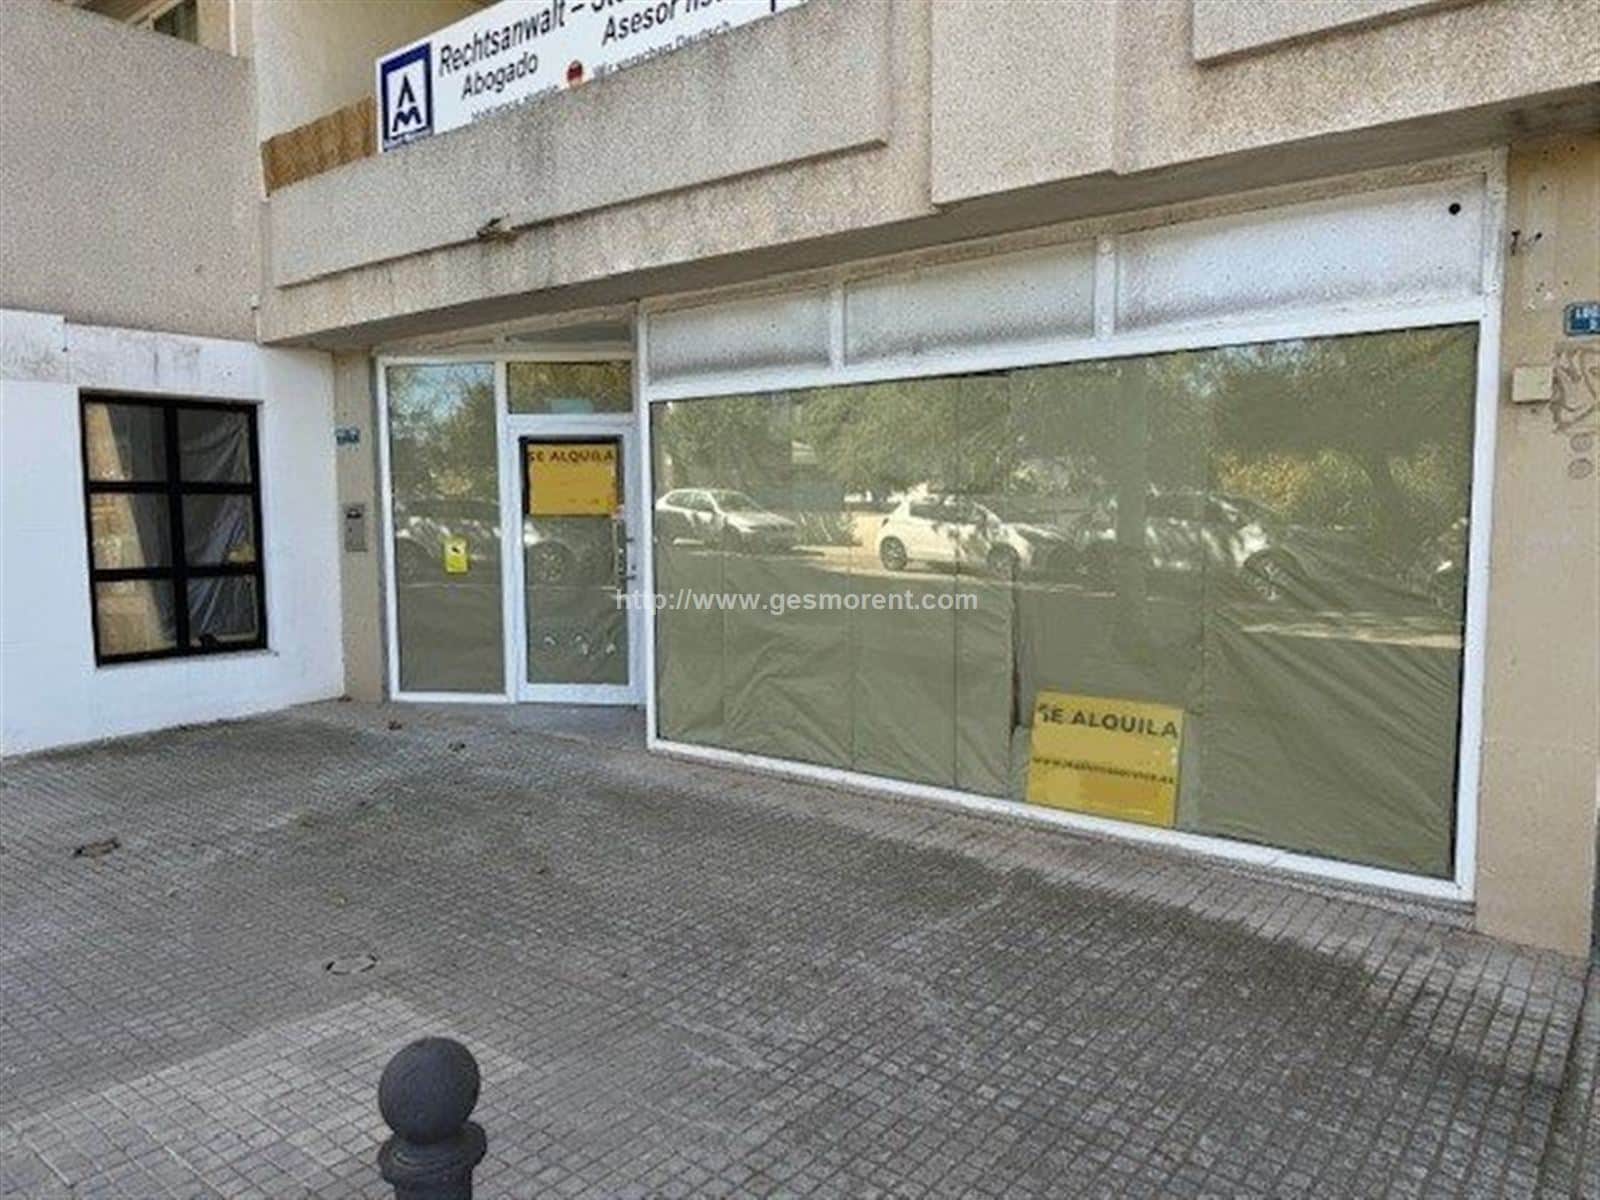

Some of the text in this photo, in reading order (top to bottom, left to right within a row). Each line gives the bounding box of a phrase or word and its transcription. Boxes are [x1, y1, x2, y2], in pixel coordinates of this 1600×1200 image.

[438, 1, 565, 76] Rechtsanwalt
[601, 0, 676, 46] Asesor
[461, 51, 538, 98] Abogado
[549, 449, 614, 463] ALQUILA
[1071, 708, 1180, 739] ALQUILA
